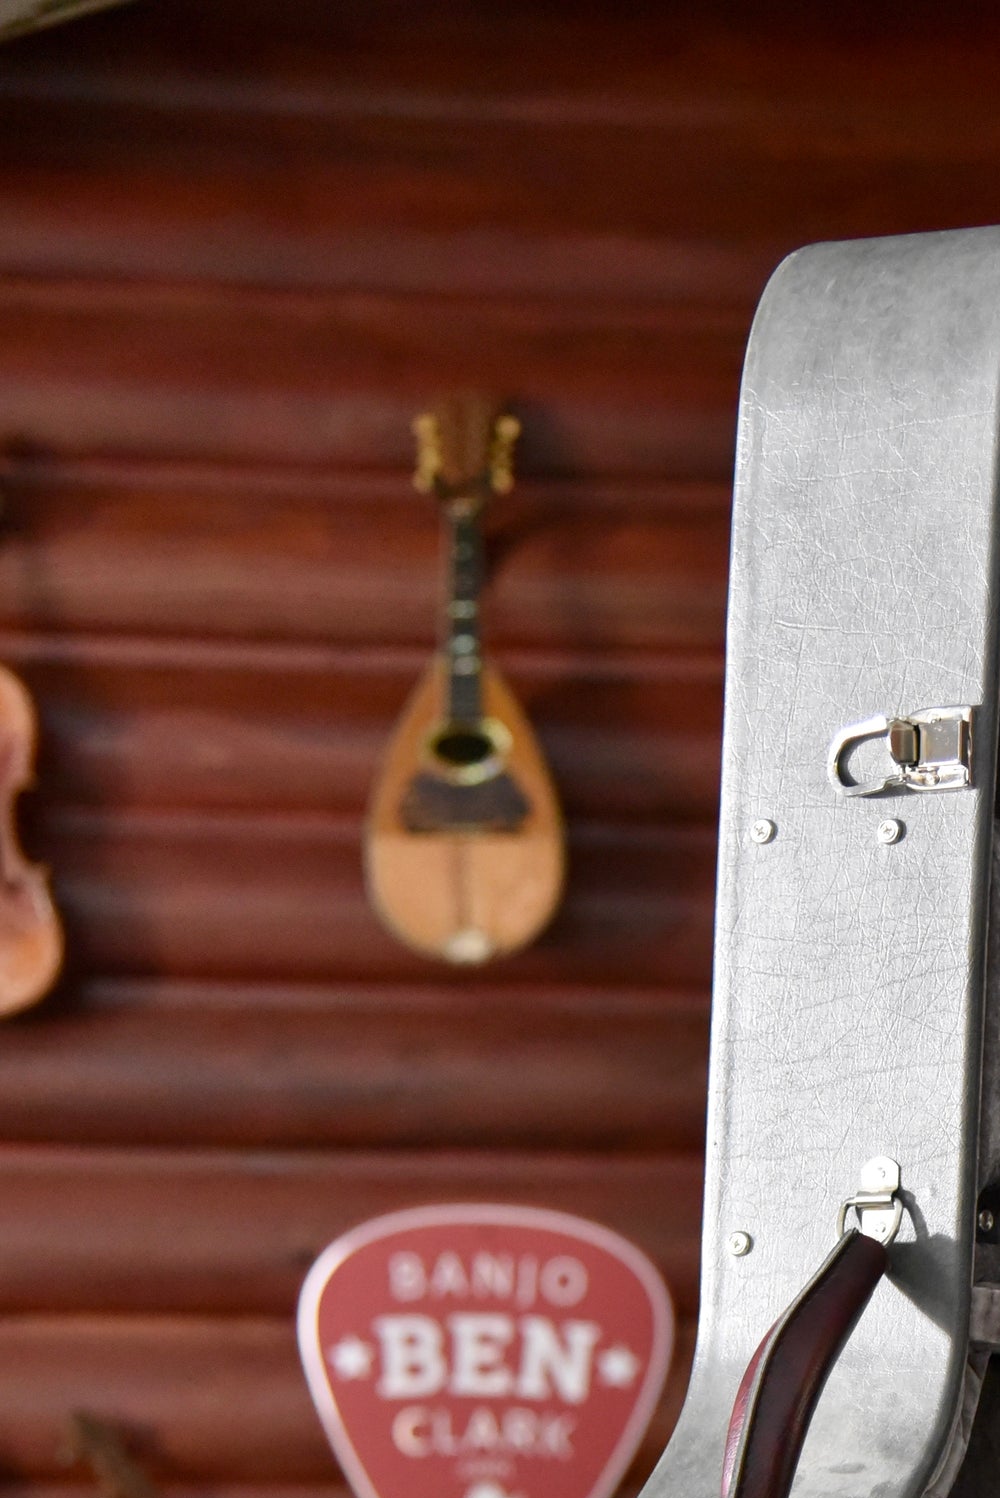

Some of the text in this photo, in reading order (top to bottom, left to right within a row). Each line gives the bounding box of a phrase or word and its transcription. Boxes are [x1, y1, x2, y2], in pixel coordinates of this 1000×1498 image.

[388, 1250, 590, 1308] BANJO
[372, 1312, 602, 1404] BEN
[392, 1406, 576, 1460] CLARK
